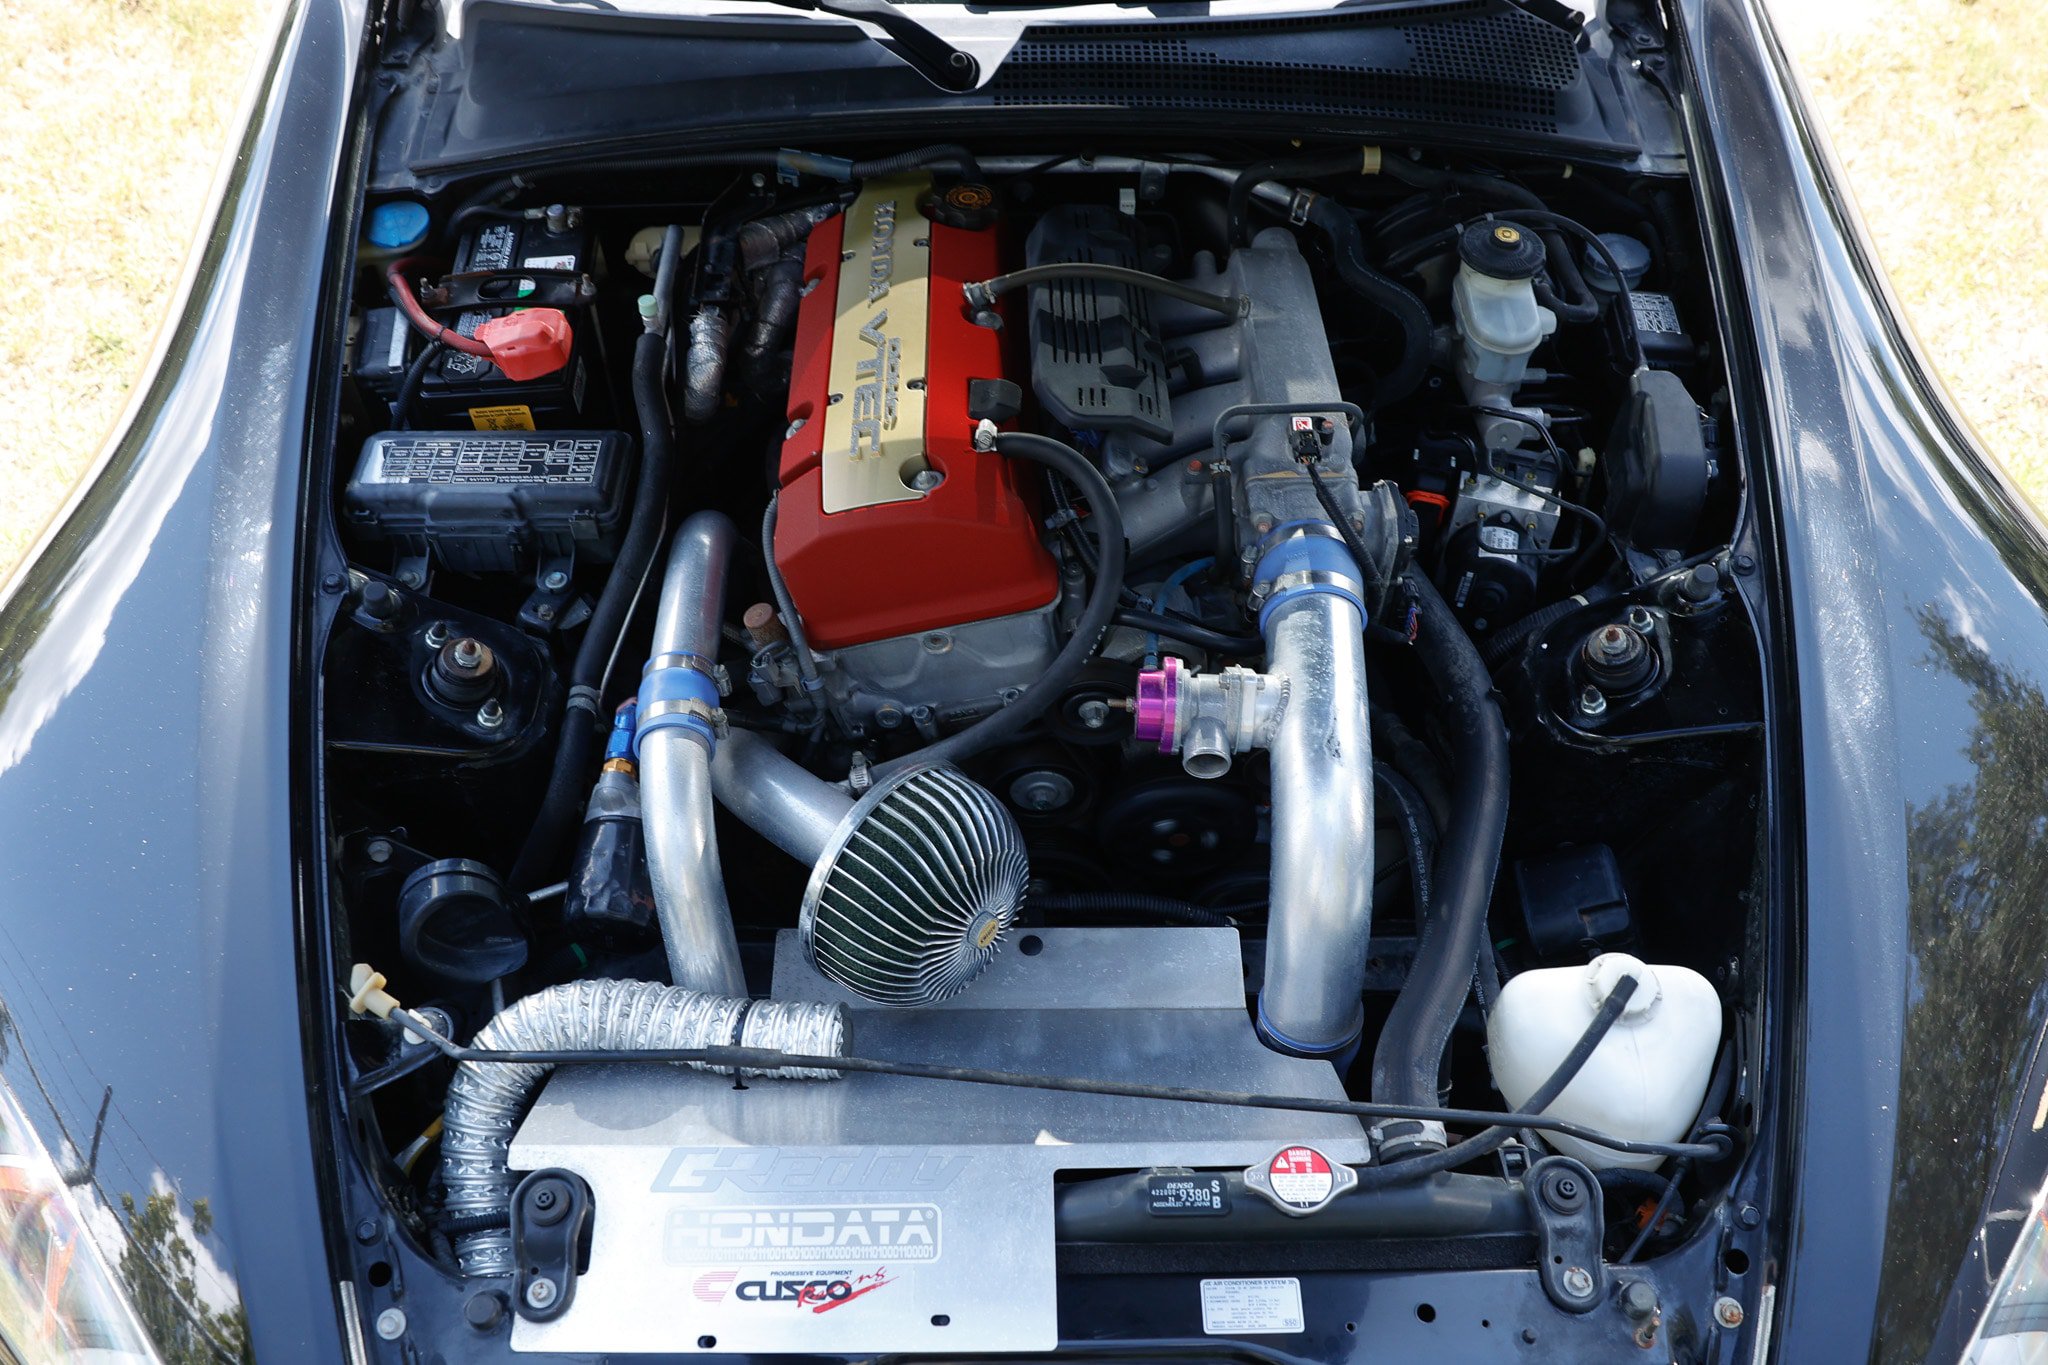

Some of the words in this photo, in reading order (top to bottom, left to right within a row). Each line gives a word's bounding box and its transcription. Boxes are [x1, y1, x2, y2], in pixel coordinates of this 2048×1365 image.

[868, 200, 897, 306] HONDA
[850, 308, 889, 459] VTEC
[885, 337, 900, 430] DOHC
[1211, 1180, 1220, 1193] S
[1212, 1195, 1221, 1209] B
[671, 1209, 934, 1247] HONDATA
[736, 1280, 853, 1301] CUSCO
